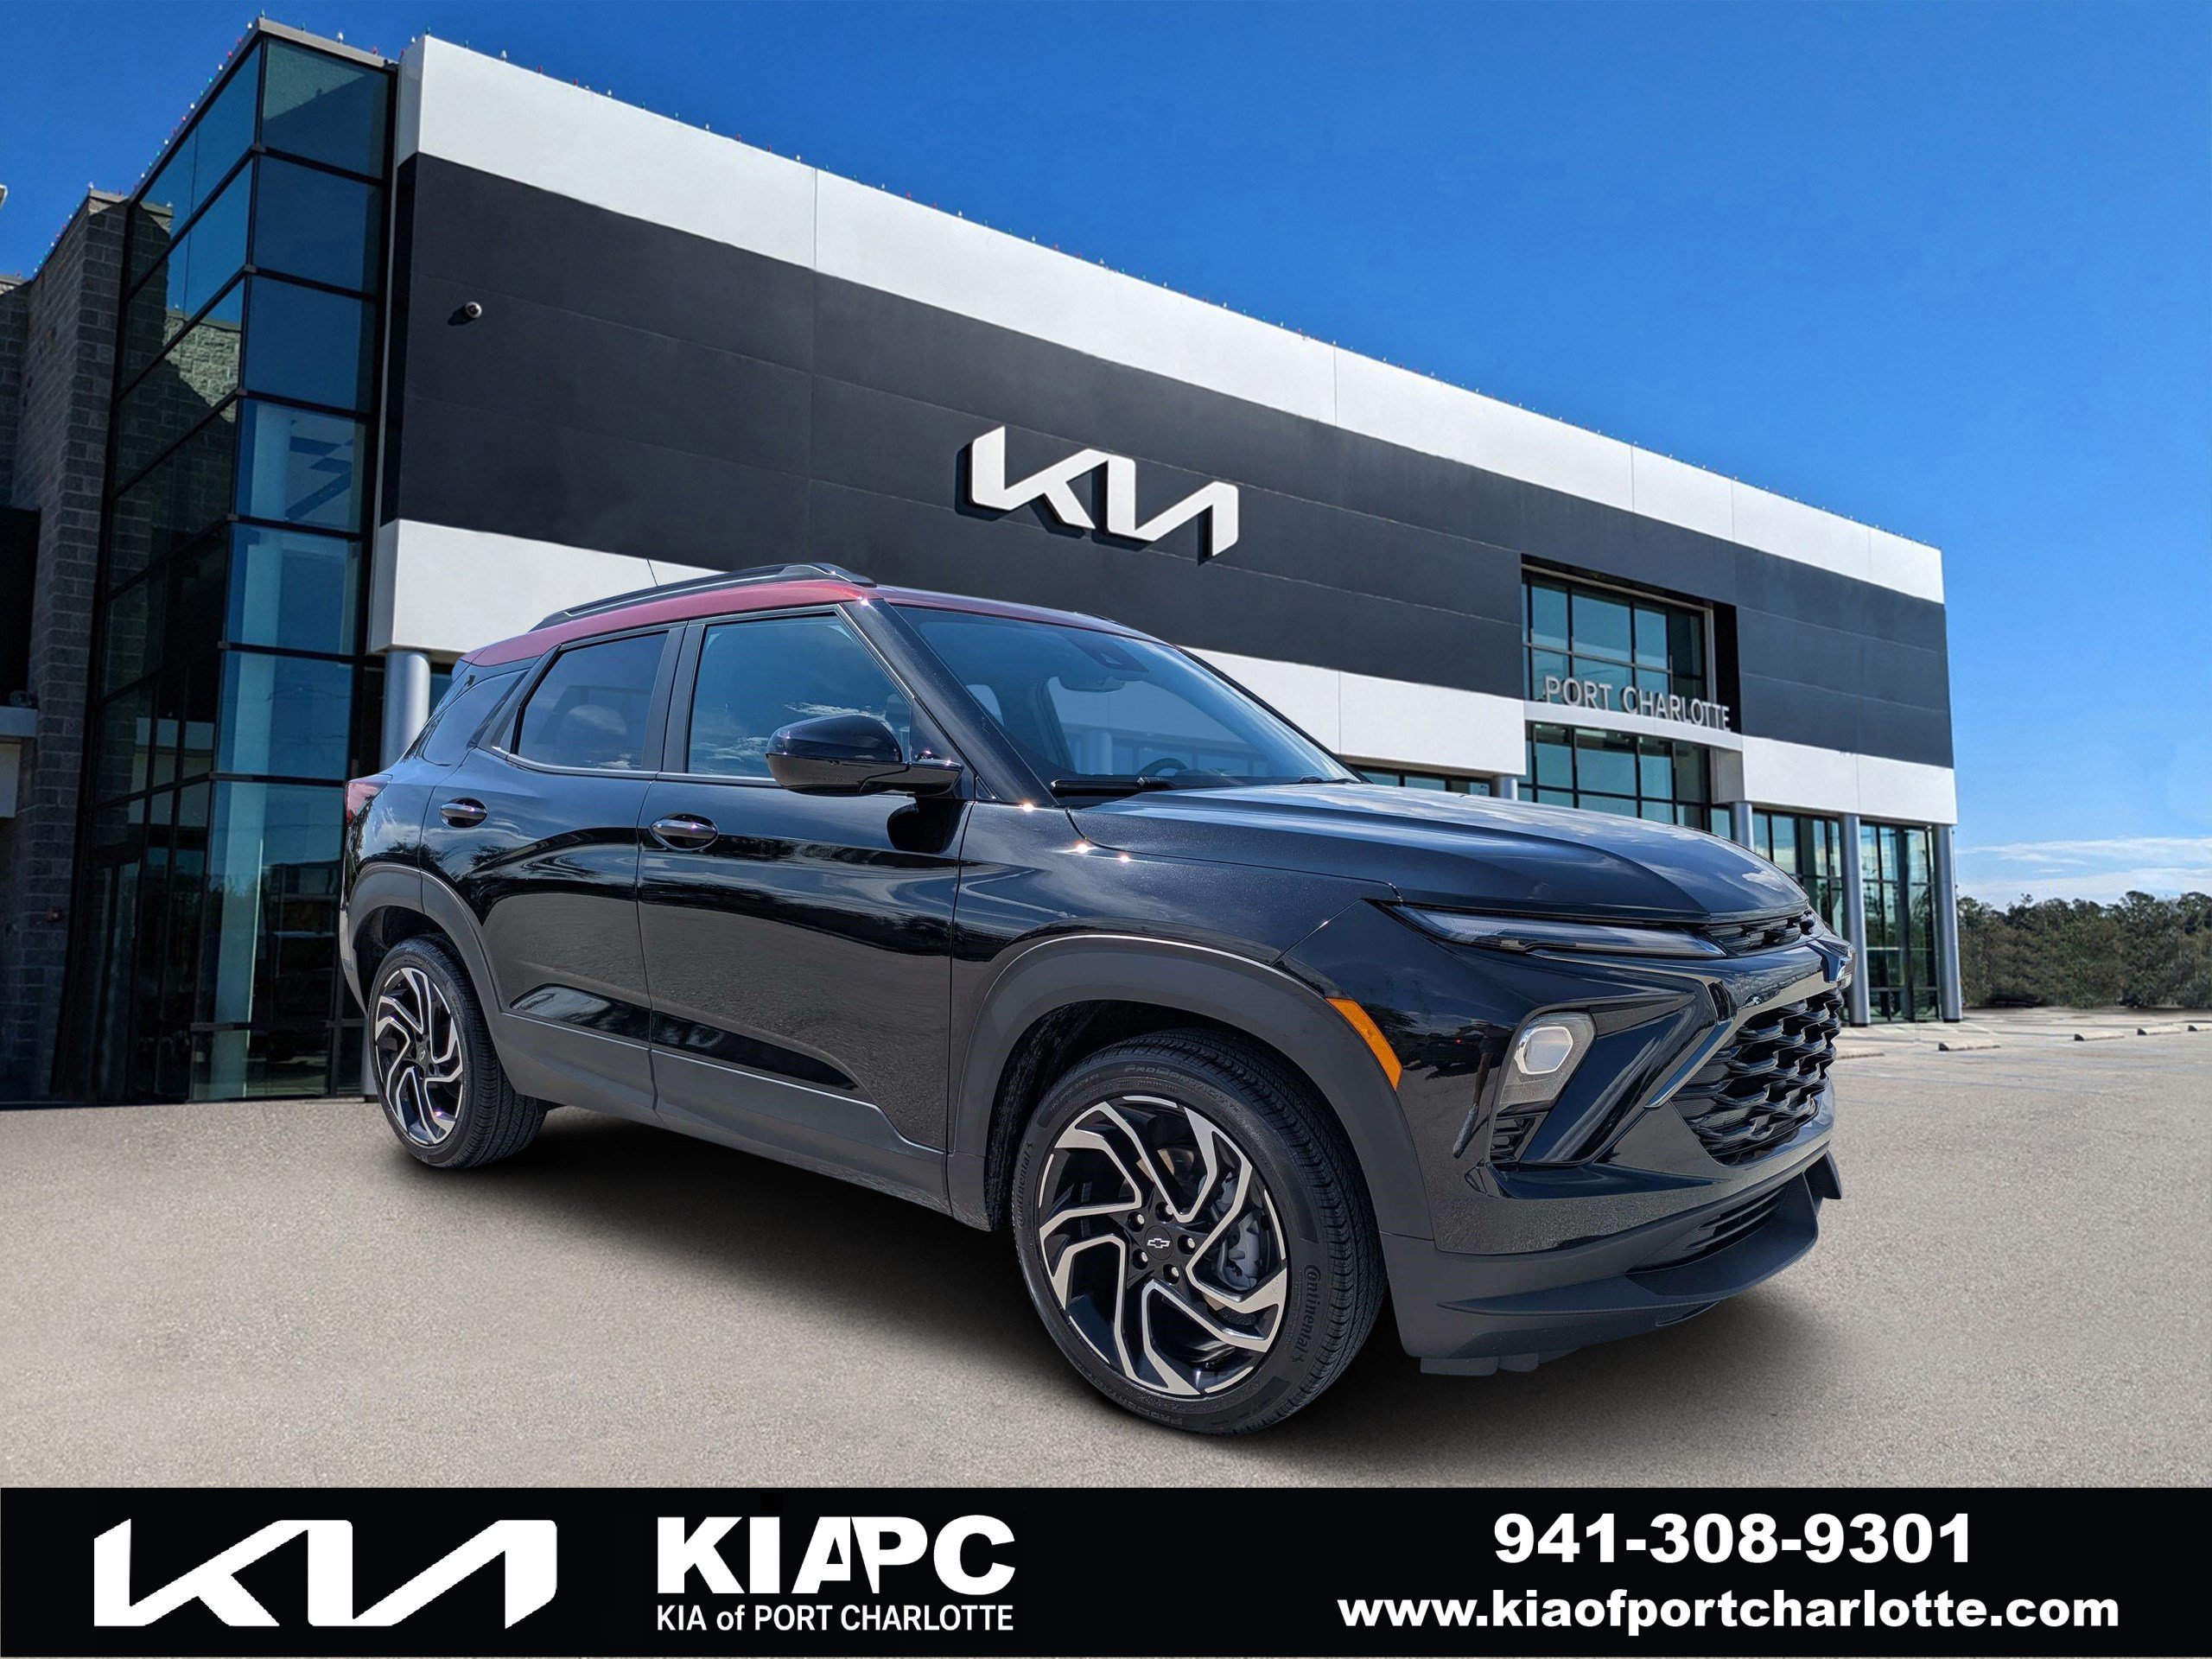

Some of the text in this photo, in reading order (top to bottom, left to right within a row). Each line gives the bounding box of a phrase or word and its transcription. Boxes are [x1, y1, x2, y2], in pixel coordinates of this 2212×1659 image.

[971, 425, 1239, 556] KIA
[1546, 676, 1731, 732] PORT CHARLOTTE
[1295, 1264, 1321, 1354] Continental
